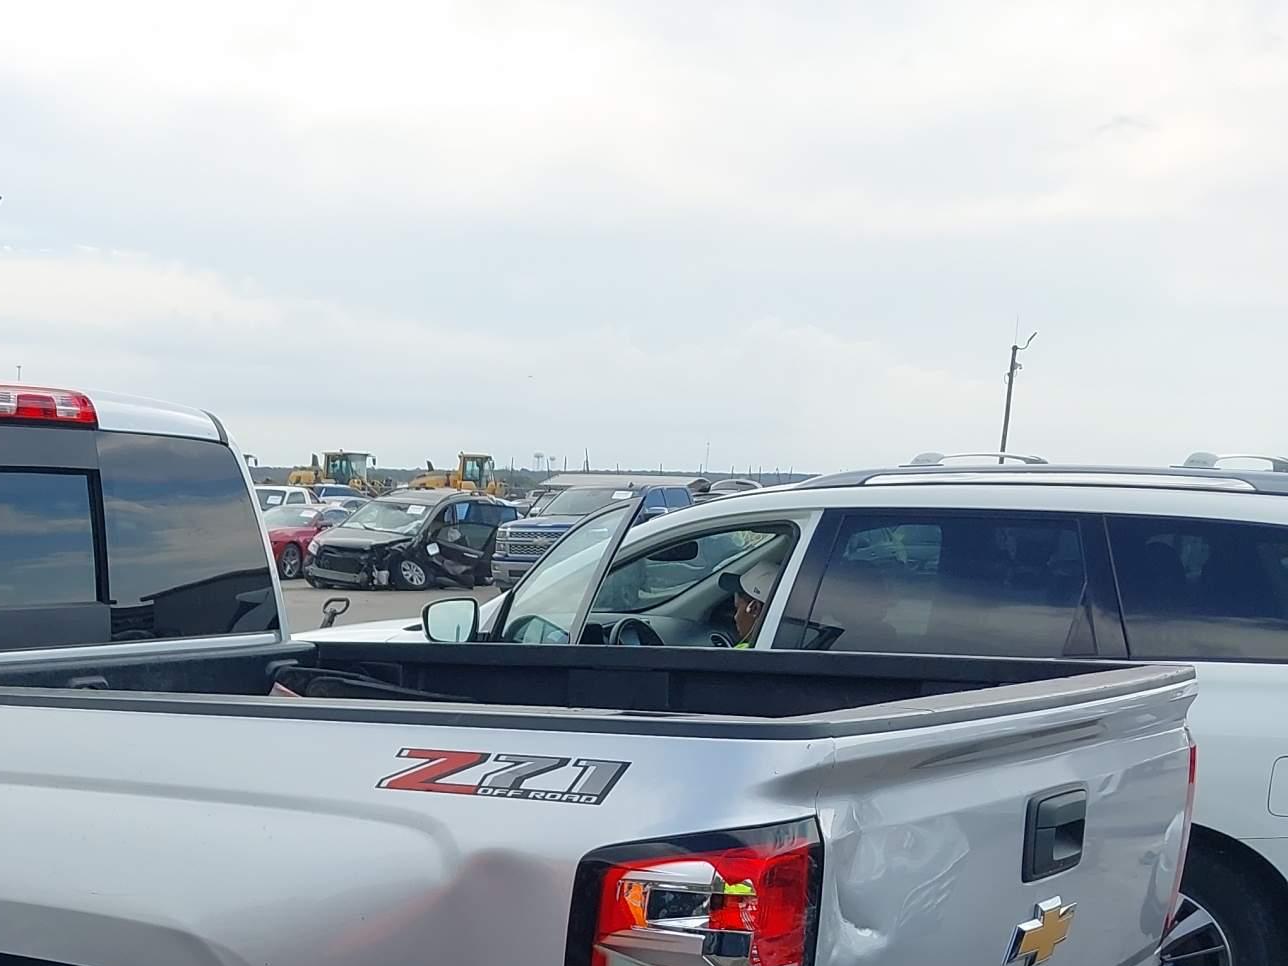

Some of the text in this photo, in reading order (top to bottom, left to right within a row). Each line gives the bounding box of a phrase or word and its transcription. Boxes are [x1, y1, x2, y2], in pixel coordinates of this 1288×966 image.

[375, 748, 632, 803] Z71
[477, 786, 599, 804] OFF ROAD
